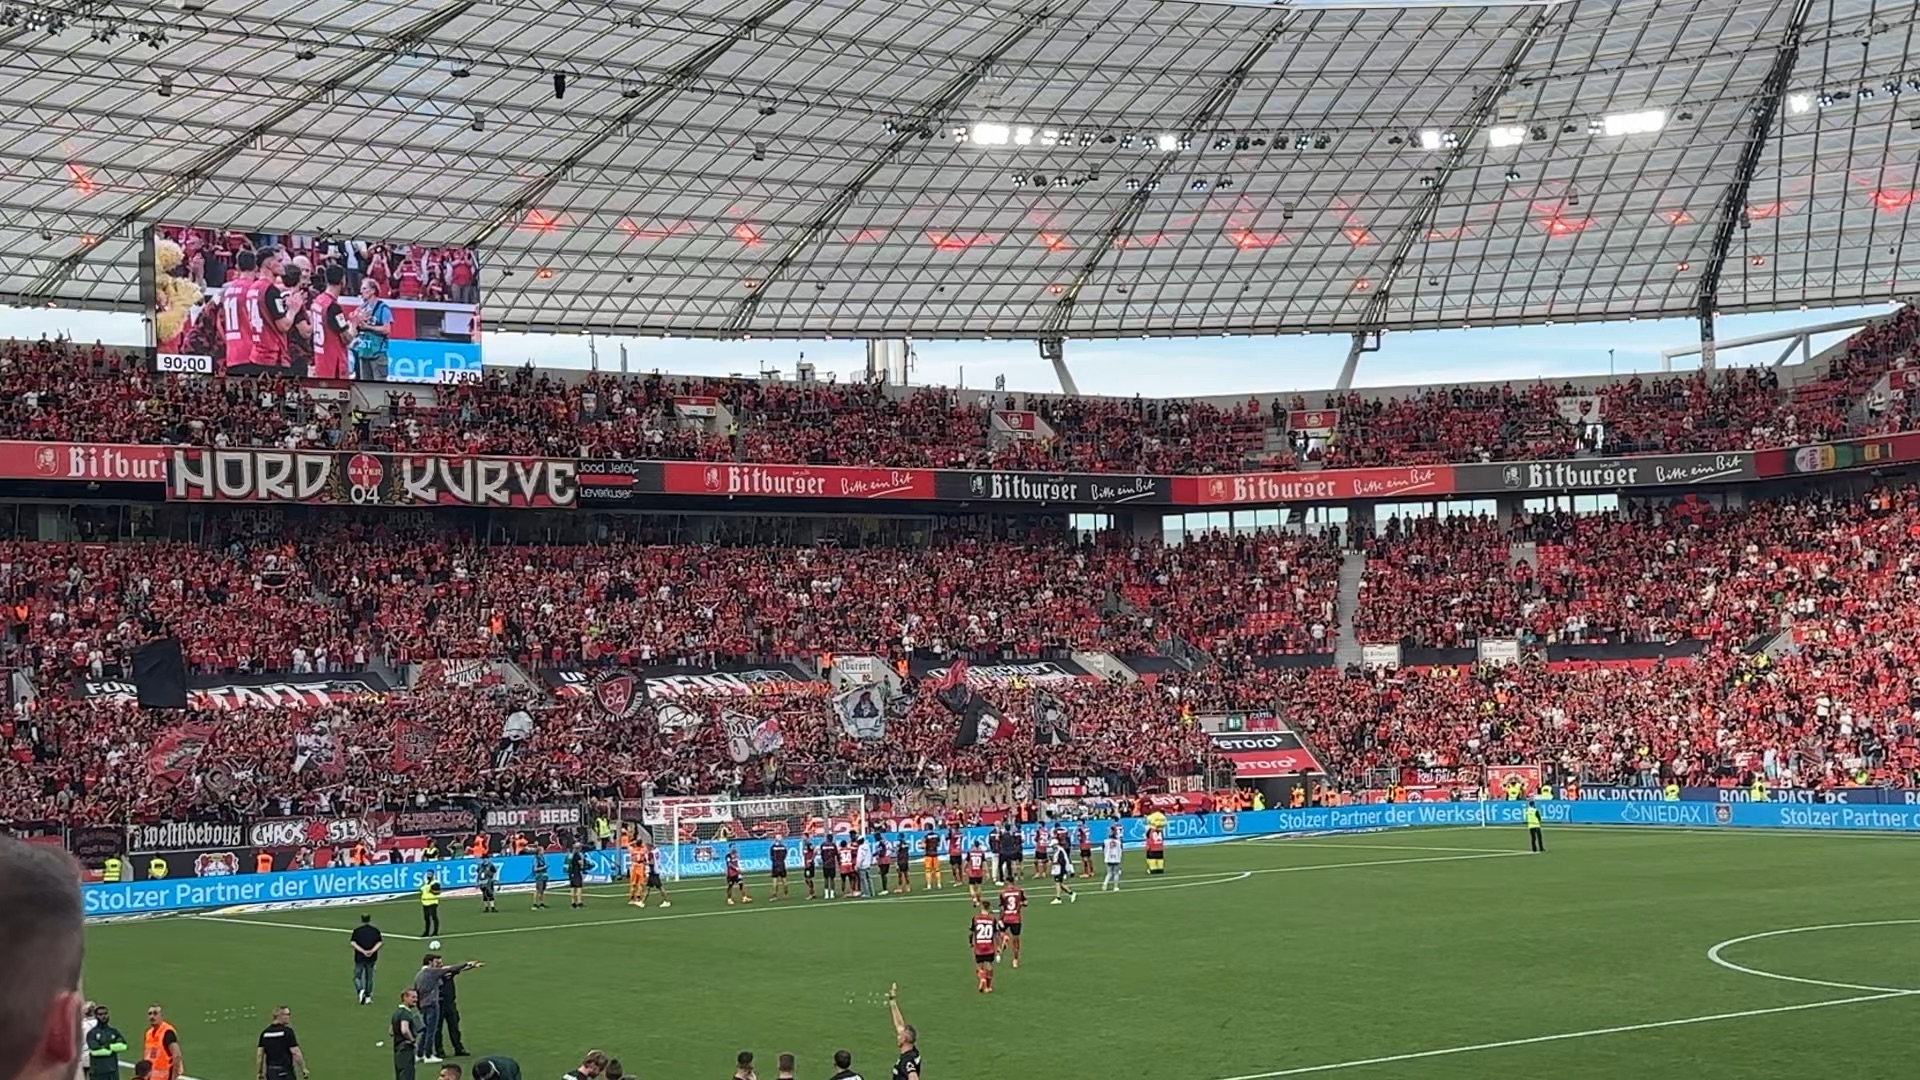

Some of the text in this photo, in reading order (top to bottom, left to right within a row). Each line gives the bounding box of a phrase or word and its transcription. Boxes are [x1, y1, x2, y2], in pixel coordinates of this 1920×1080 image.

[163, 356, 206, 371] 90:00
[402, 456, 576, 505] KURVE
[727, 466, 825, 495] Bitburger
[990, 474, 1078, 500] Bitburger
[1527, 463, 1638, 488] Bitburger
[350, 484, 380, 504] 04
[1232, 476, 1336, 501] Bitburger
[1279, 804, 1571, 831] Stolzer Partner der Werkself sei 1997
[1641, 805, 1701, 822] NIEDAX
[1780, 806, 1838, 826] Stolzer
[1843, 808, 1908, 827] Partner
[328, 817, 359, 842] 513
[970, 856, 982, 867] 10
[85, 886, 169, 912] Stolzer
[176, 879, 264, 906] Partner
[271, 875, 308, 898] der
[313, 866, 409, 895] Werkself
[456, 862, 504, 884] 197
[1007, 896, 1016, 910] 3
[976, 923, 993, 939] 20
